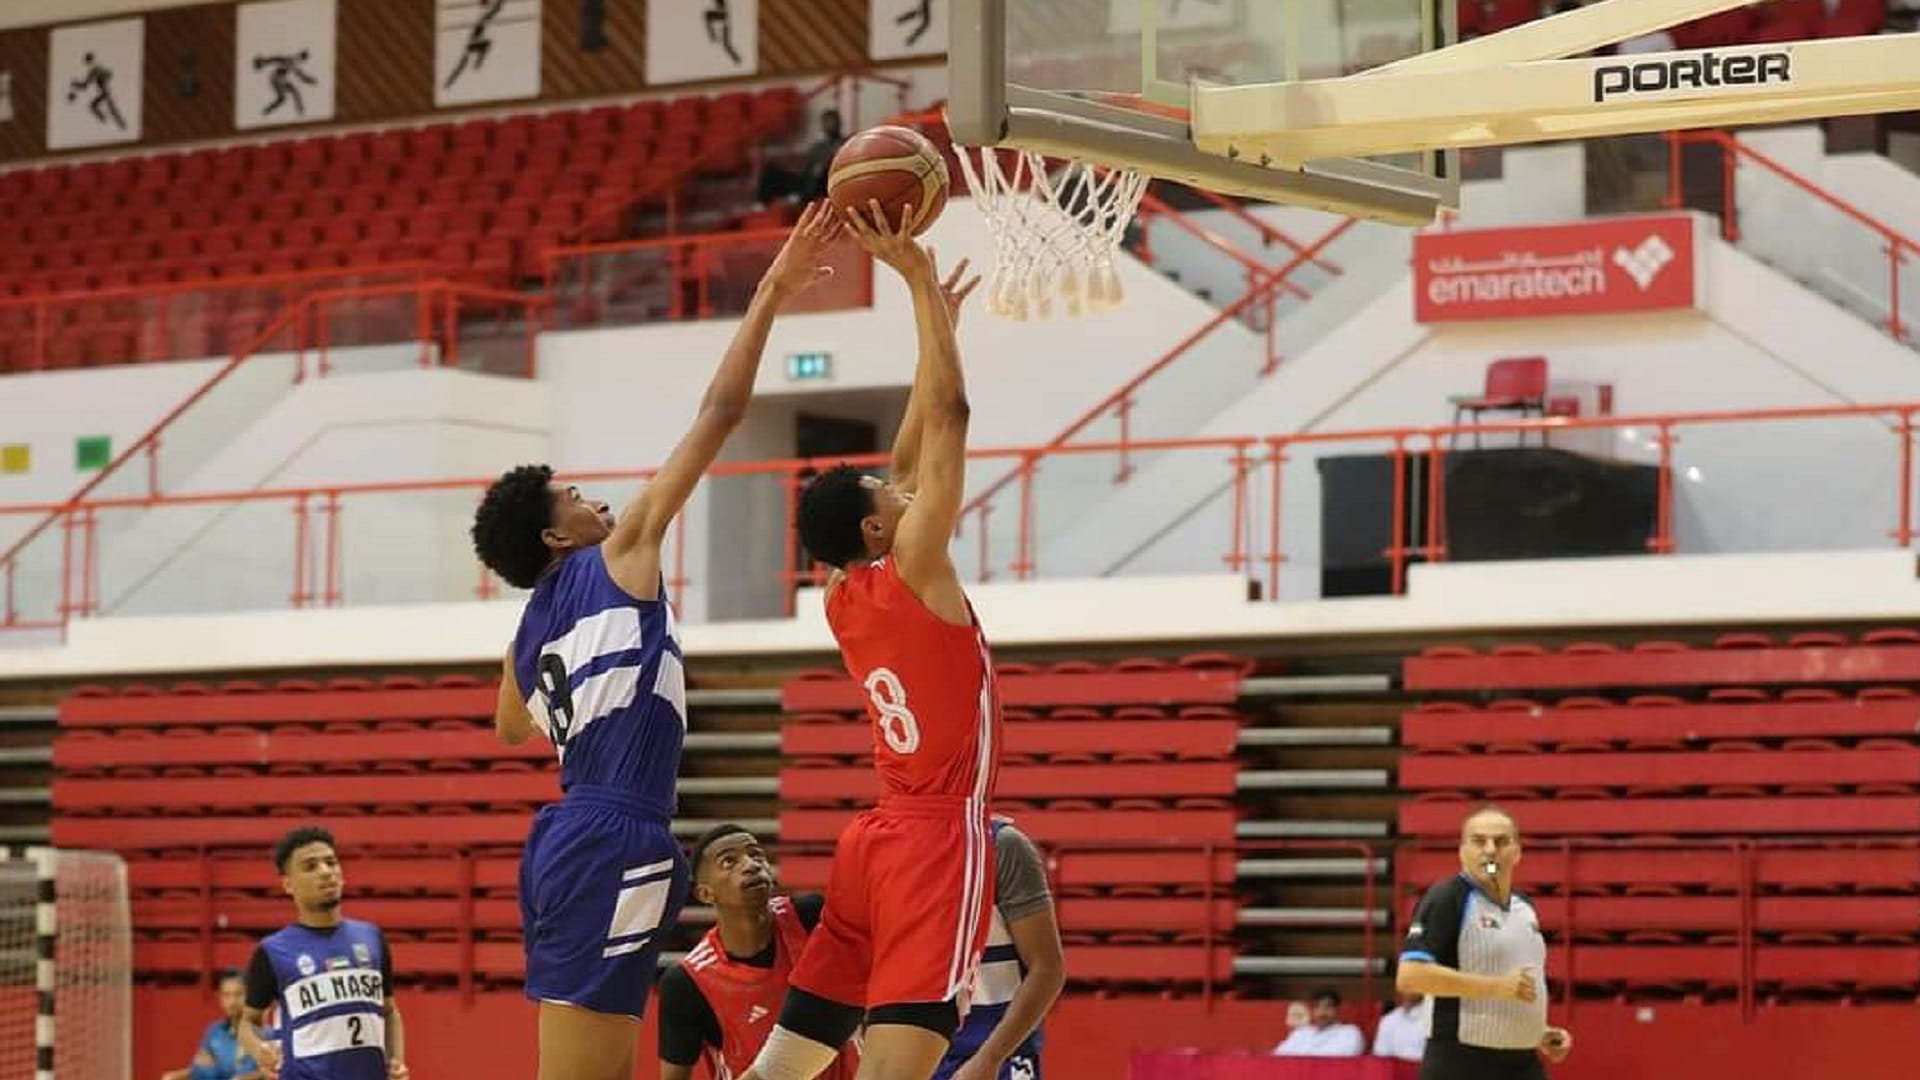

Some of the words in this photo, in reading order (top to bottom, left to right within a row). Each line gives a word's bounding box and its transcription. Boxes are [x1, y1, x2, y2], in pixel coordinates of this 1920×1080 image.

[1428, 265, 1605, 305] emaratech
[864, 667, 919, 754] 8
[299, 981, 328, 1009] AL
[347, 1016, 363, 1046] 2
